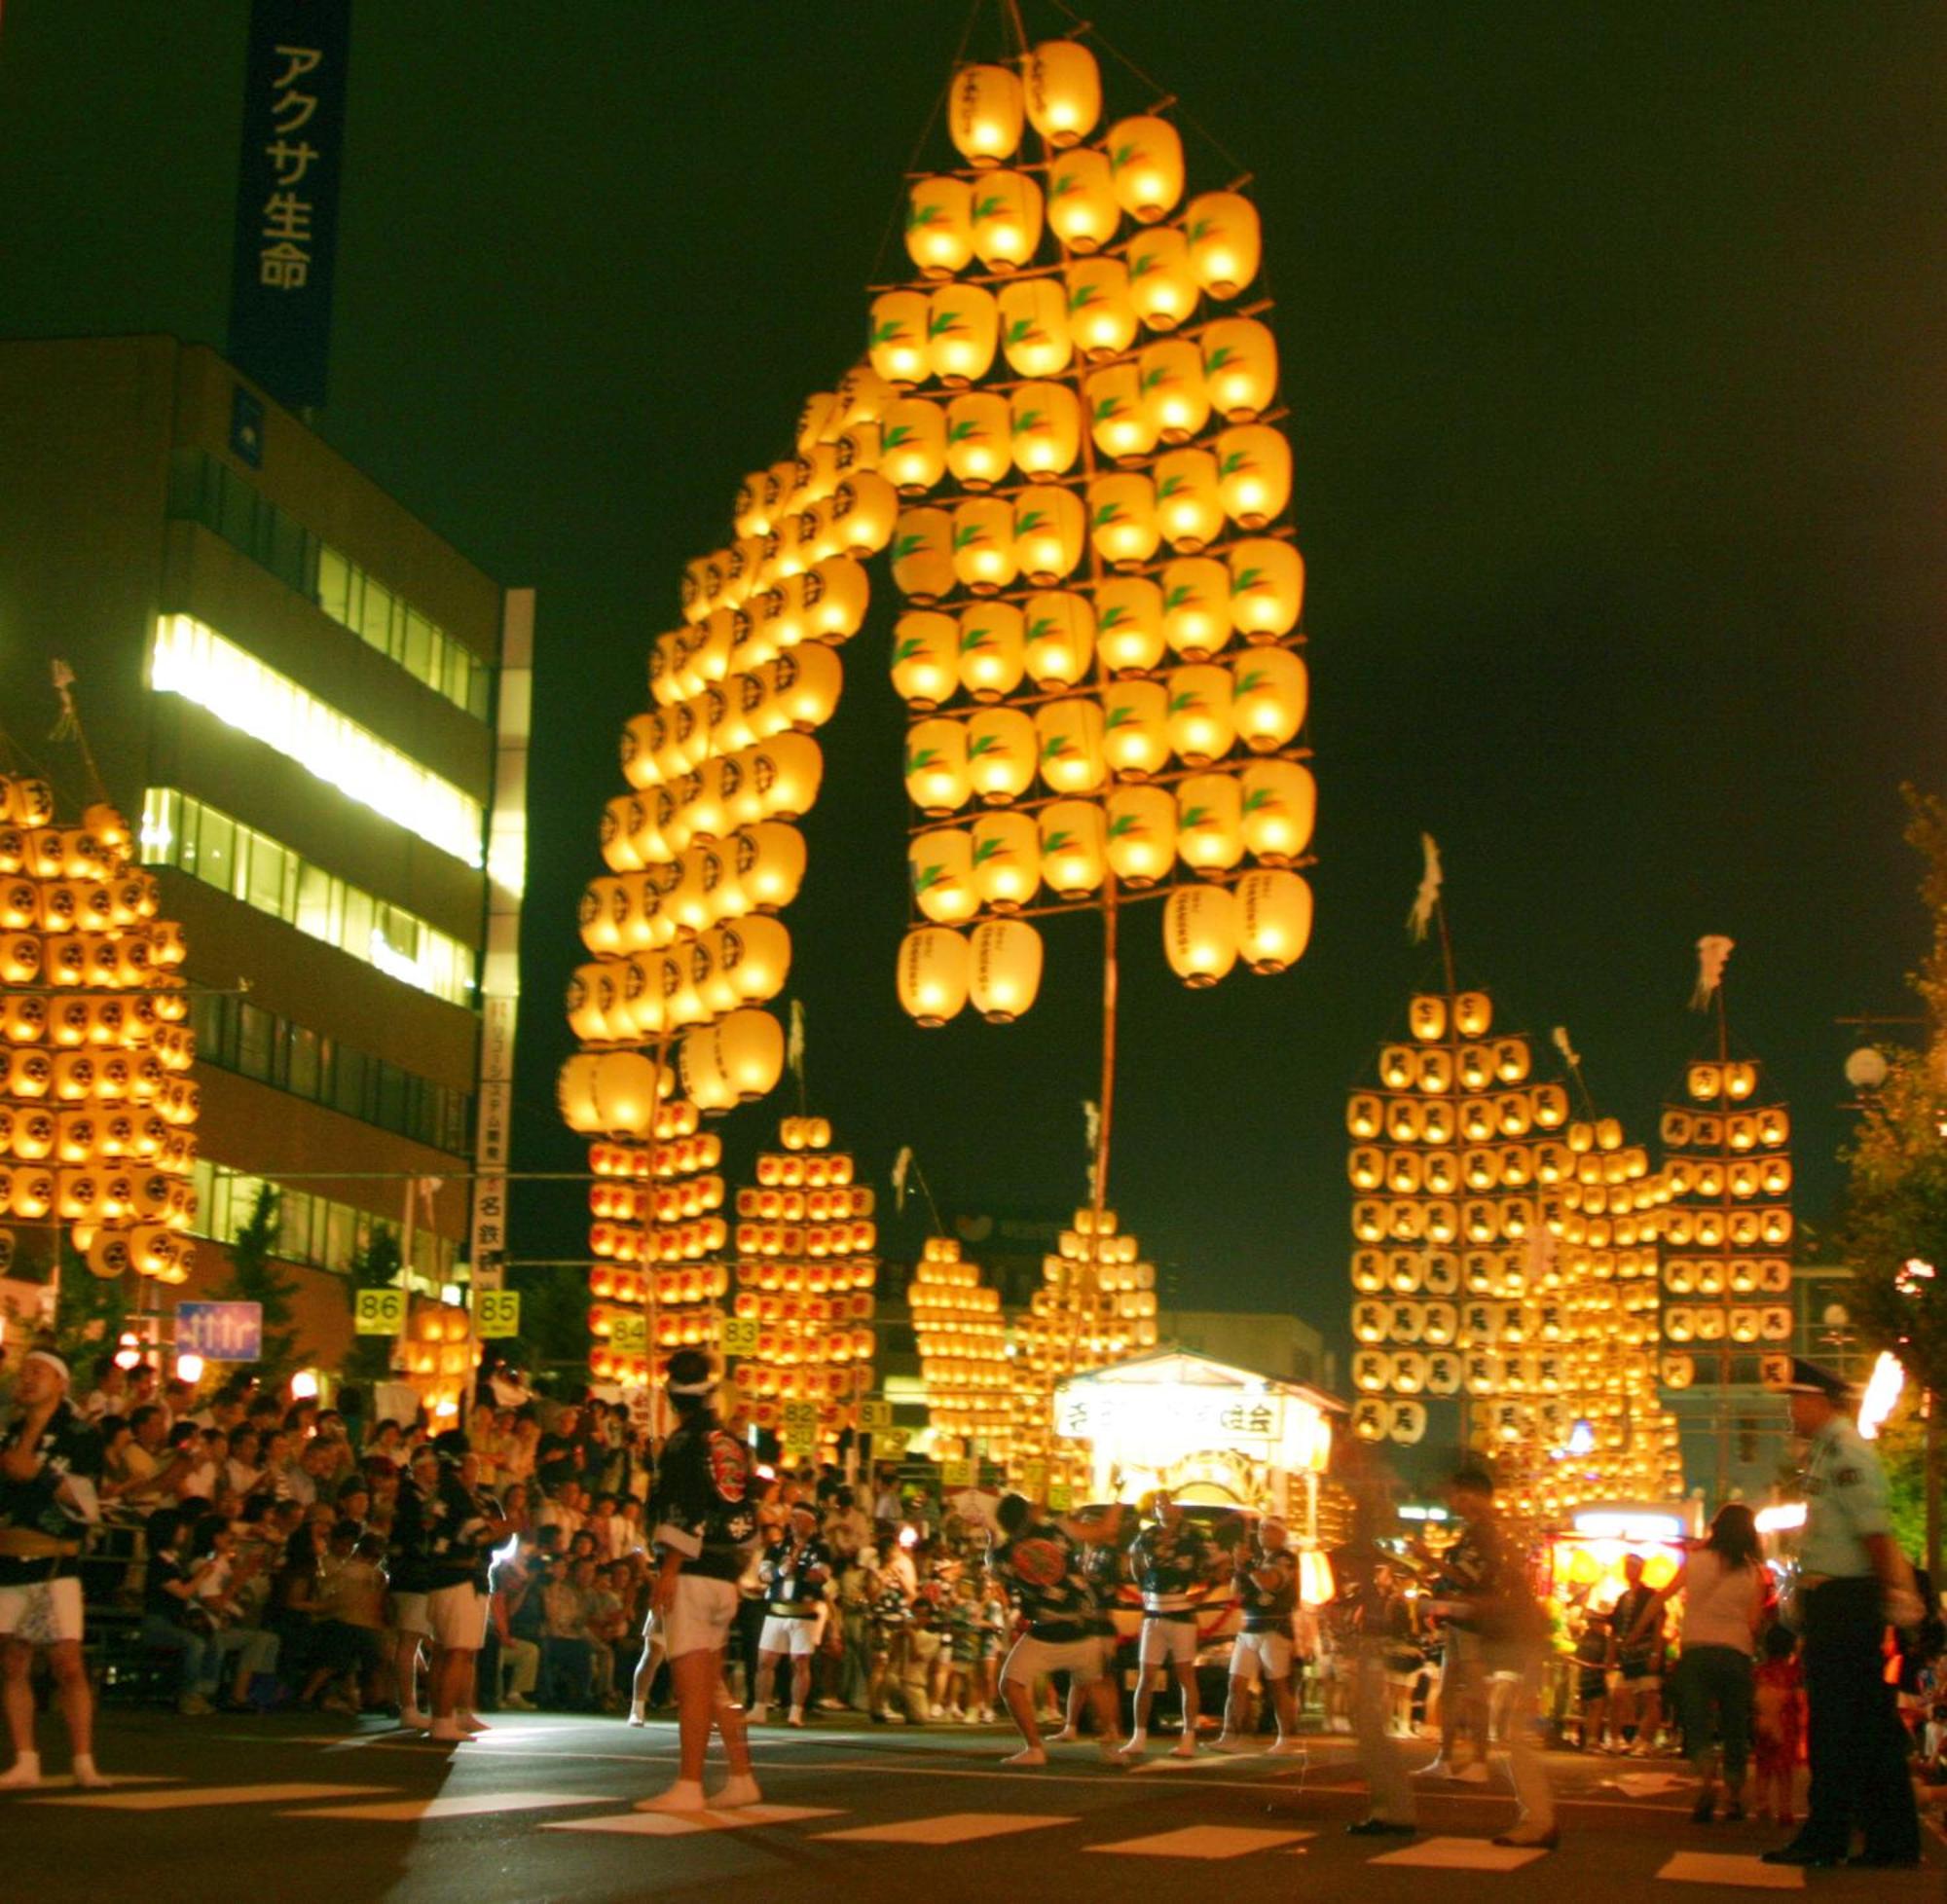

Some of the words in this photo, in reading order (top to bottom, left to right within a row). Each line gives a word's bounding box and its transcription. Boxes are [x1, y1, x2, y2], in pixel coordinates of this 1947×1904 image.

[259, 45, 323, 290] アクサ生命
[361, 1296, 398, 1319] 86
[480, 1297, 515, 1321] 85
[614, 1320, 645, 1341] 84
[725, 1322, 756, 1342] 83
[785, 1404, 812, 1422] 82
[862, 1405, 887, 1422] 81
